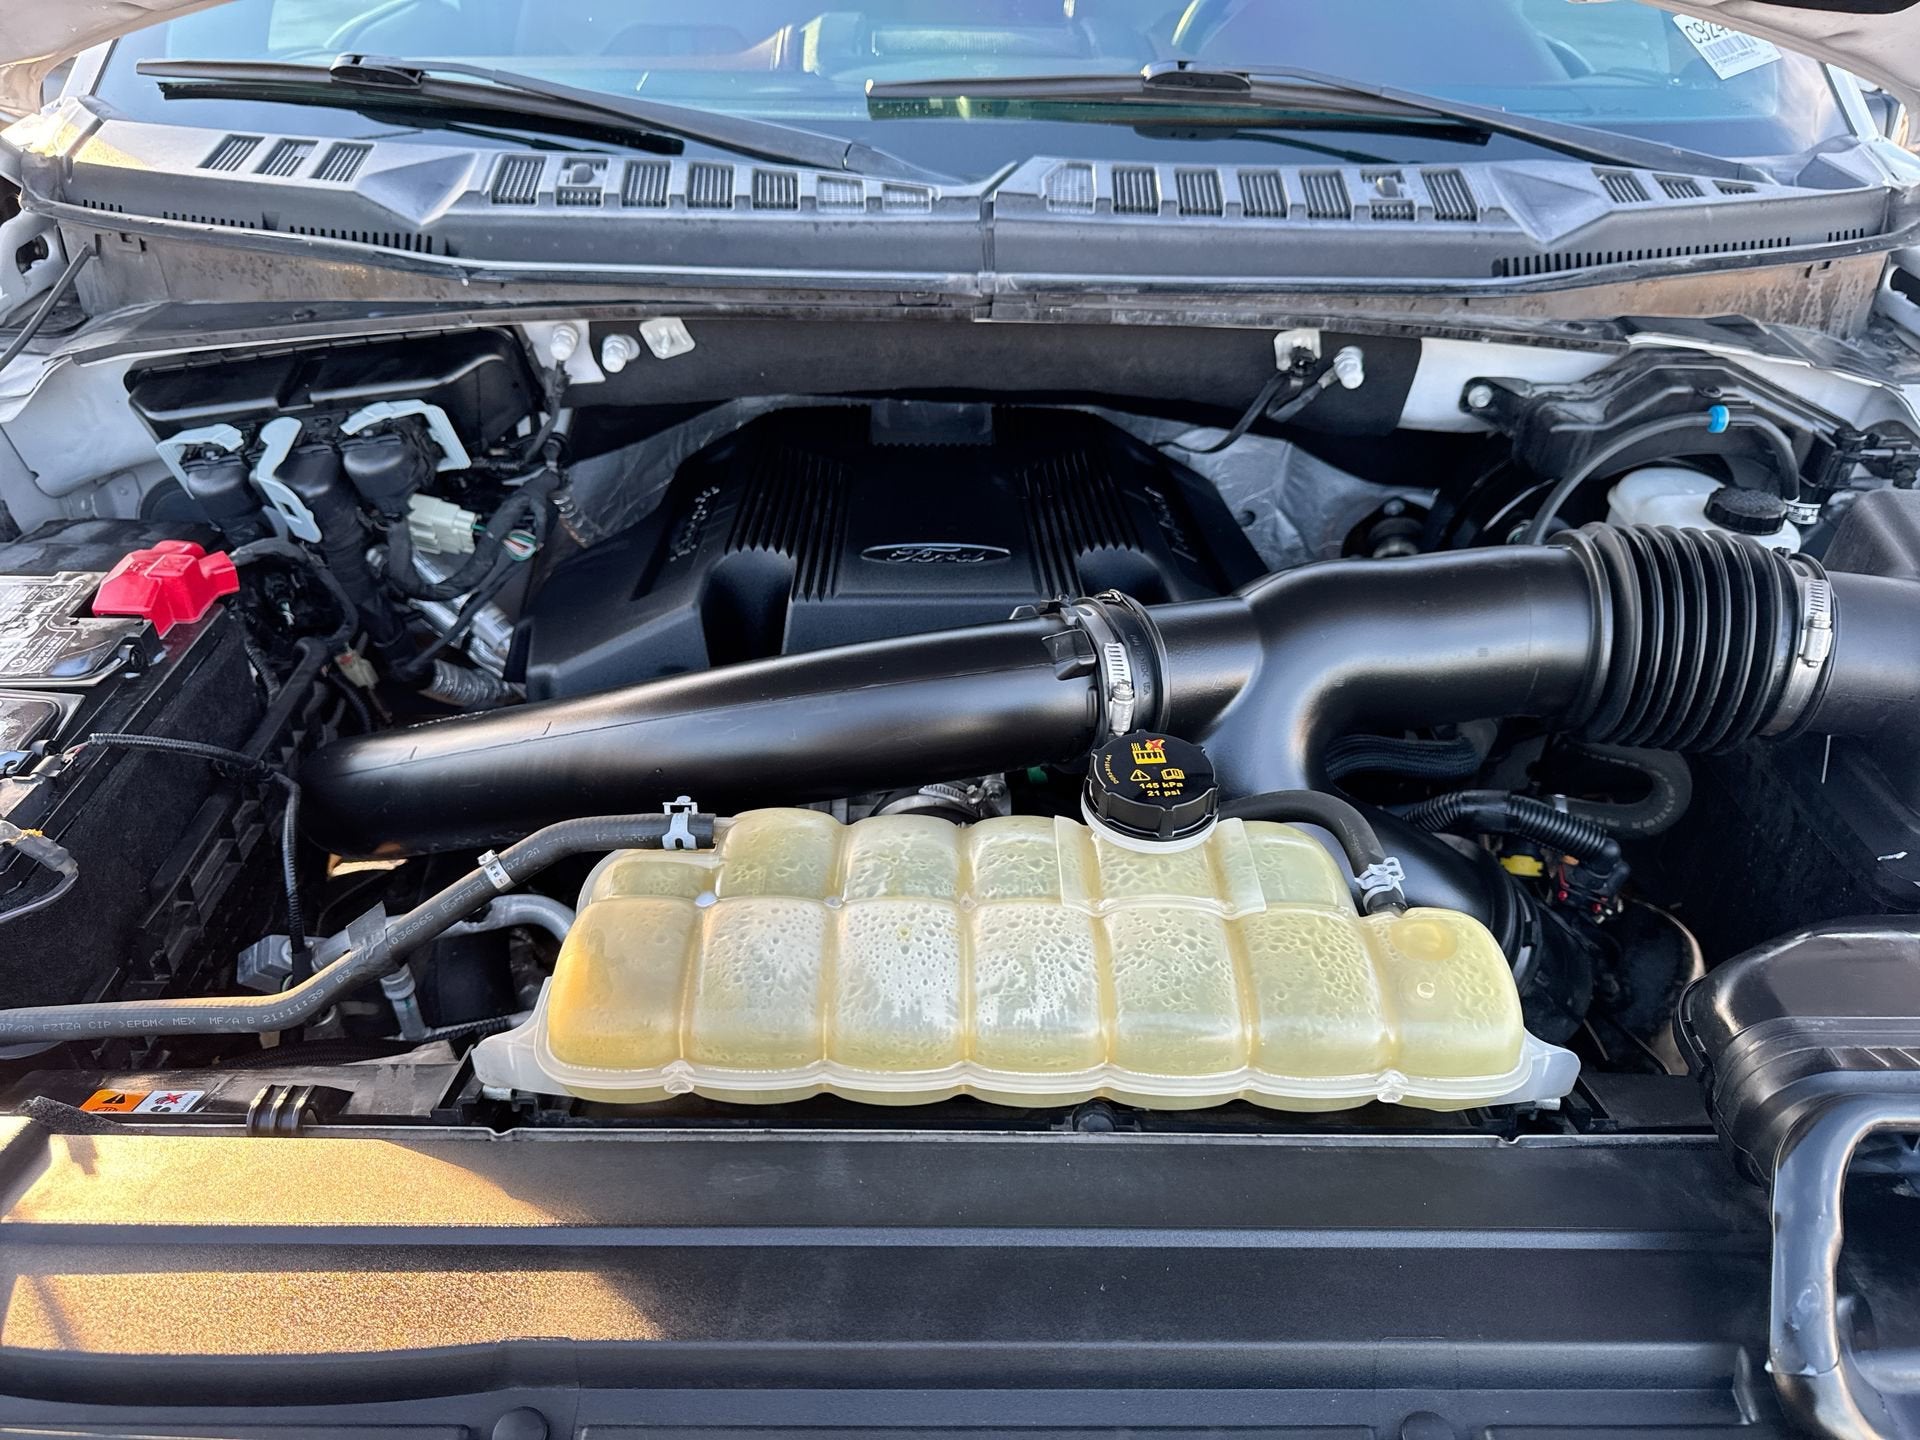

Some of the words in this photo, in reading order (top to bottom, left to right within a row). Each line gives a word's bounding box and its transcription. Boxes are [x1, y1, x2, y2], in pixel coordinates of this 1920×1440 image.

[884, 547, 987, 564] Ford
[1164, 789, 1180, 797] psi
[88, 1020, 111, 1029] CIP
[173, 1016, 196, 1026] MEX
[263, 988, 325, 1023] 21:11:39
